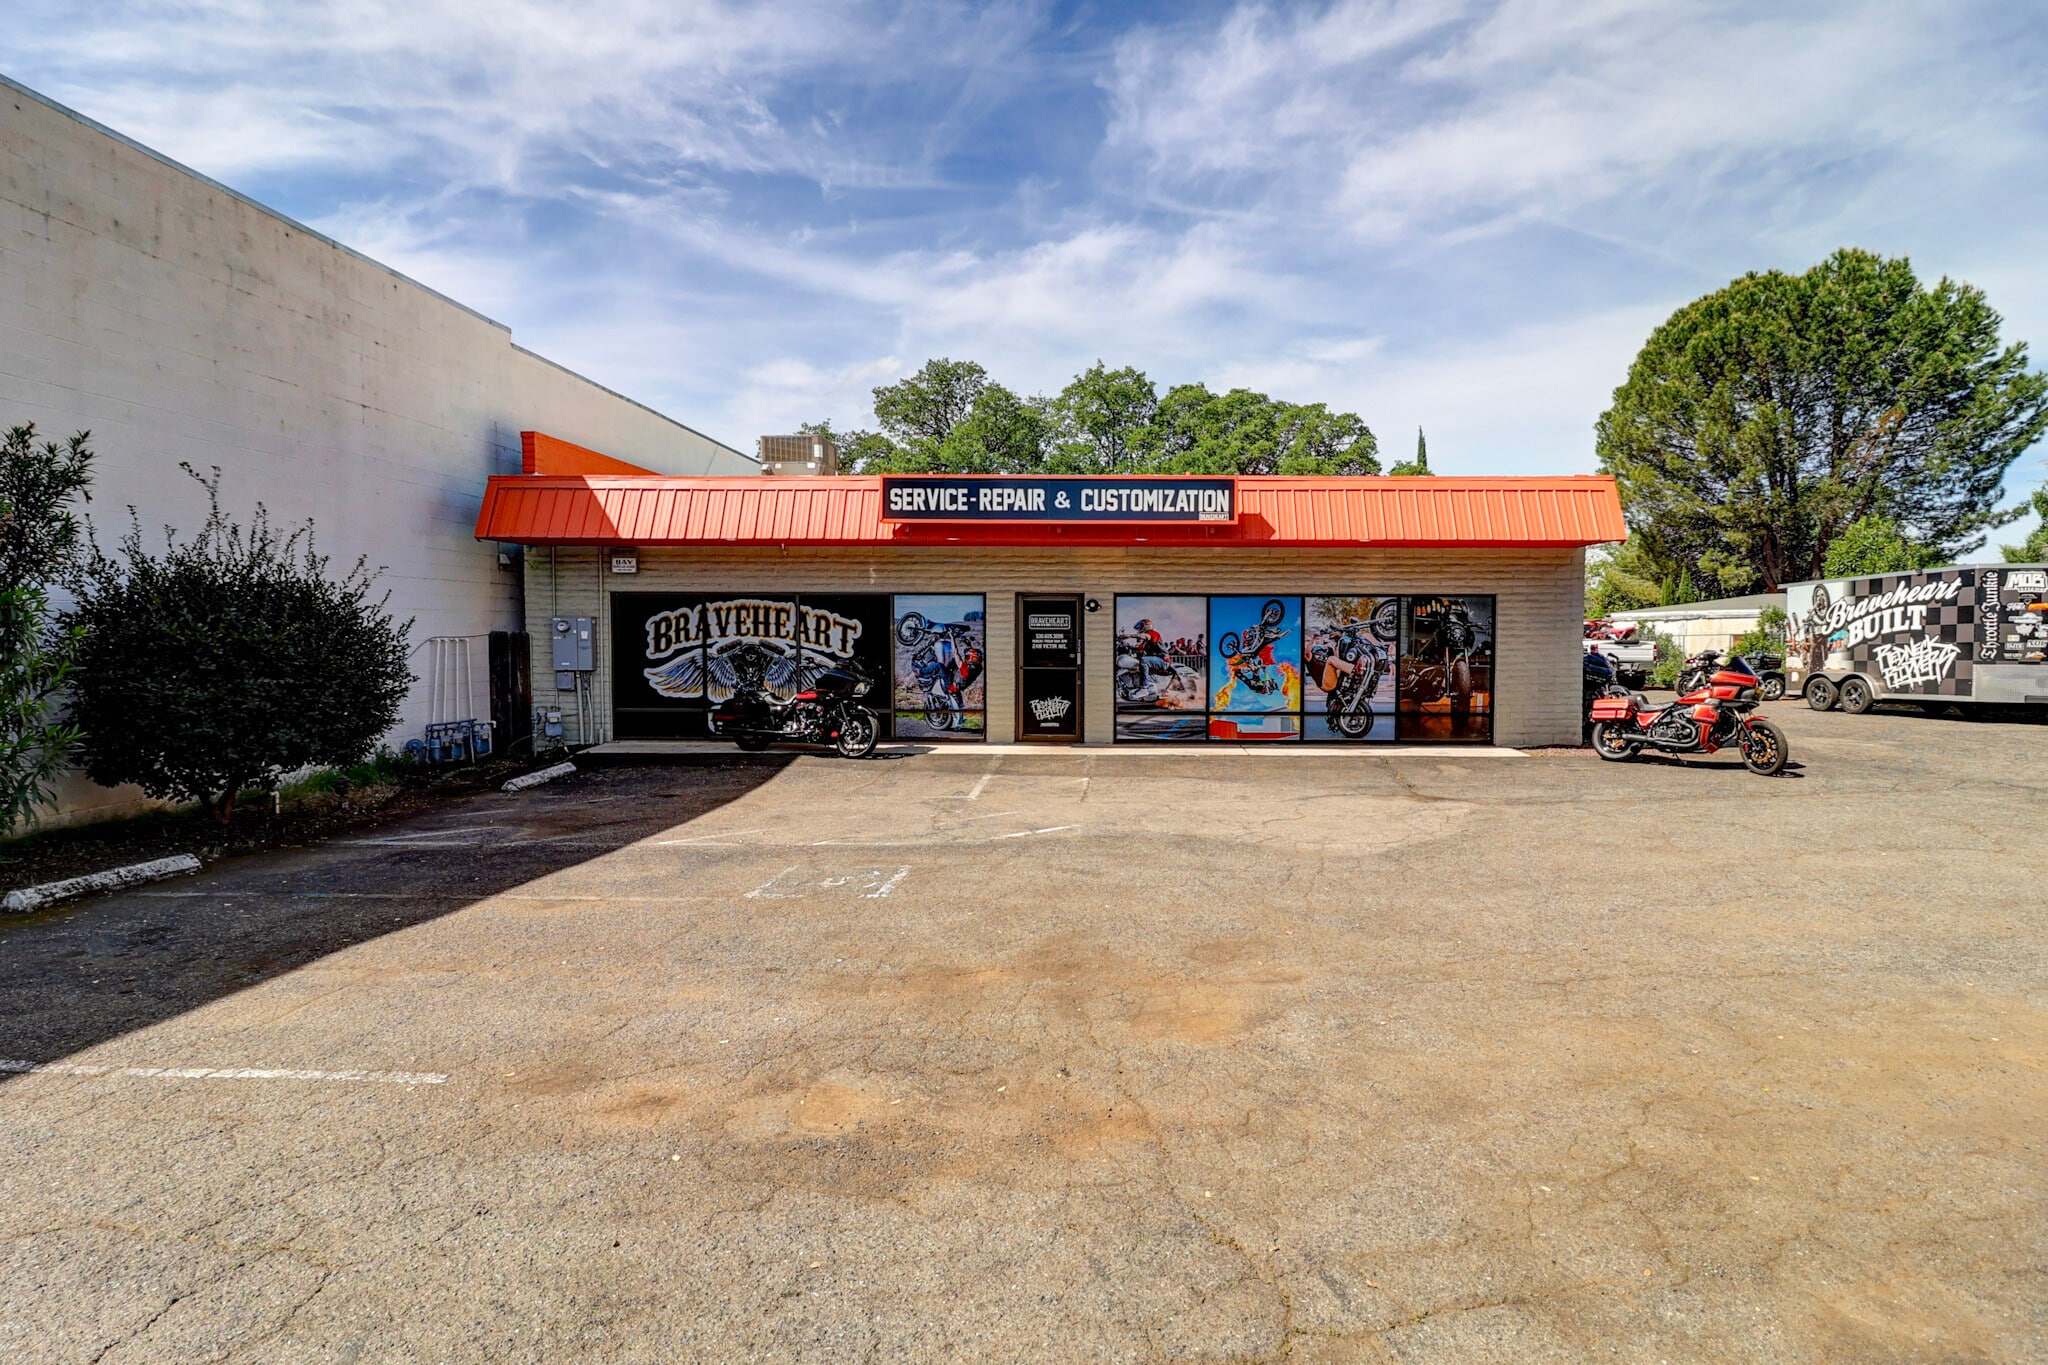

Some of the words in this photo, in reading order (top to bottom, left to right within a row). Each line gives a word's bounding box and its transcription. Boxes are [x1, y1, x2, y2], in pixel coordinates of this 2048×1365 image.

[1054, 490, 1071, 509] &
[1080, 488, 1230, 512] CUSTOMIZATION
[1980, 571, 2001, 613] Junkie
[2008, 573, 2046, 588] MOB
[1821, 577, 1962, 635] Braveheart
[1847, 604, 1927, 648] BUILT
[648, 602, 860, 656] BRAVEHEART
[1980, 612, 2001, 660] Throttle
